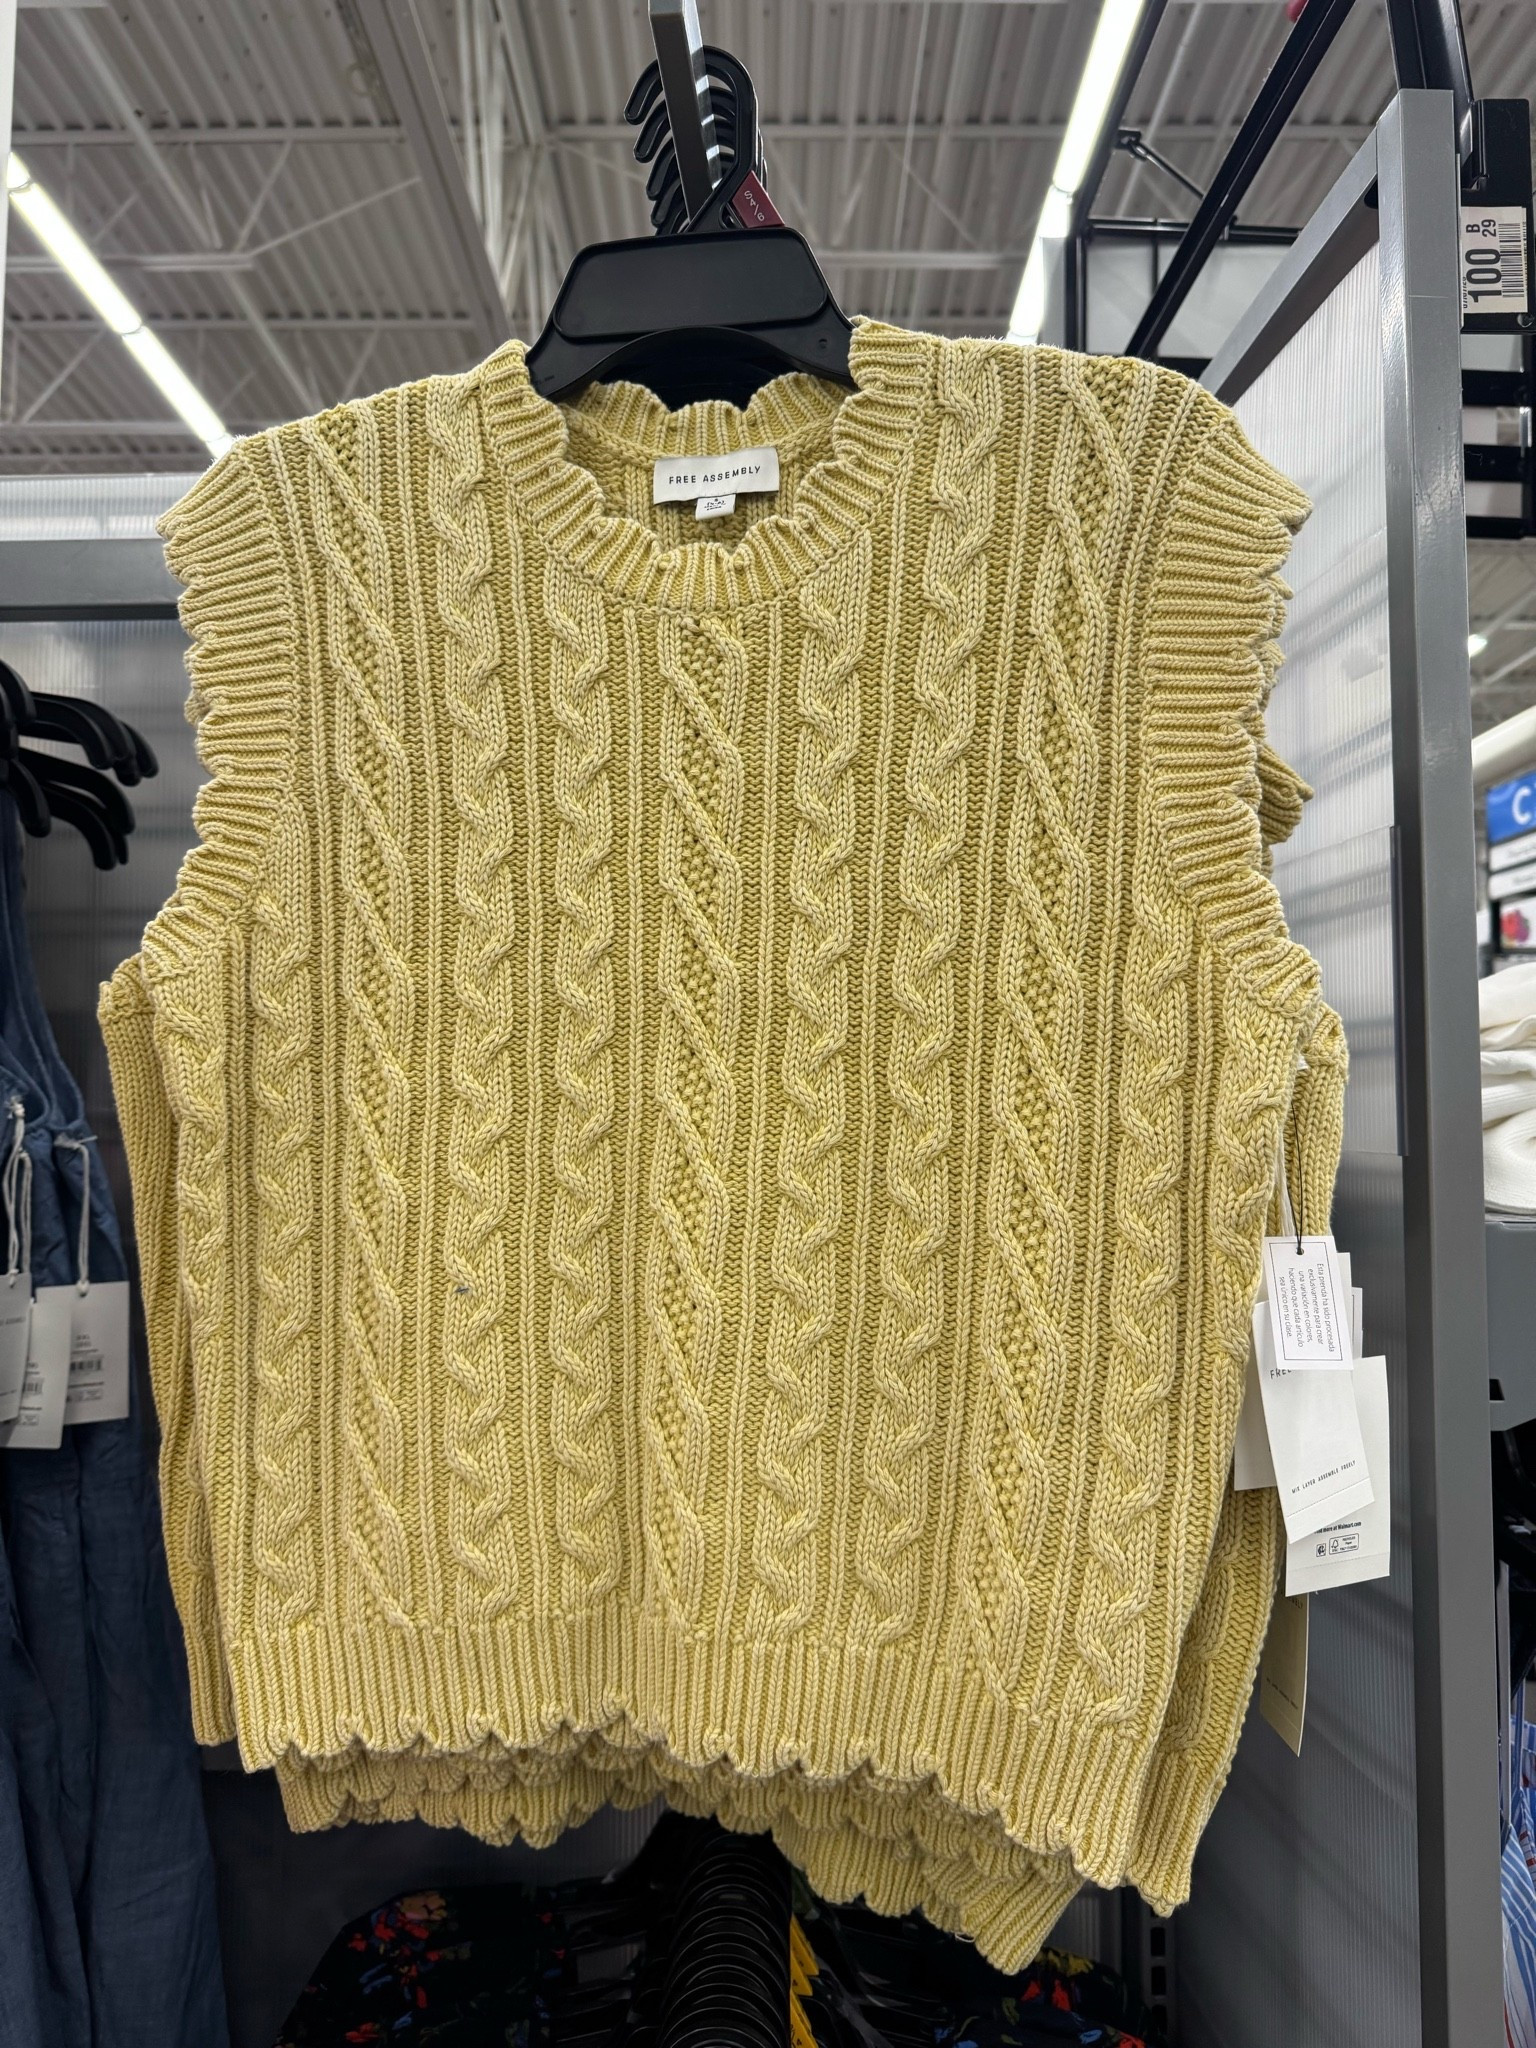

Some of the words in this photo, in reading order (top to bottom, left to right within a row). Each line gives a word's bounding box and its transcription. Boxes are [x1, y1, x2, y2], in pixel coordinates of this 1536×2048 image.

[1465, 223, 1481, 233] B
[1481, 218, 1497, 238] 29
[1464, 248, 1502, 303] 100
[668, 475, 697, 485] FREE
[702, 465, 761, 483] ASSEMBLY
[1511, 784, 1536, 825] C
[1288, 1267, 1298, 1295] haciendo
[1318, 1276, 1328, 1298] prenda
[1283, 1304, 1289, 1313] en
[1291, 1295, 1299, 1308] que
[1284, 1313, 1290, 1321] su
[1304, 1310, 1310, 1319] en
[1323, 1306, 1331, 1320] sido
[1313, 1314, 1321, 1329] para
[1316, 1329, 1324, 1345] crear
[1325, 1320, 1336, 1352] procesada
[1337, 1521, 1362, 1530] Walmart.com
